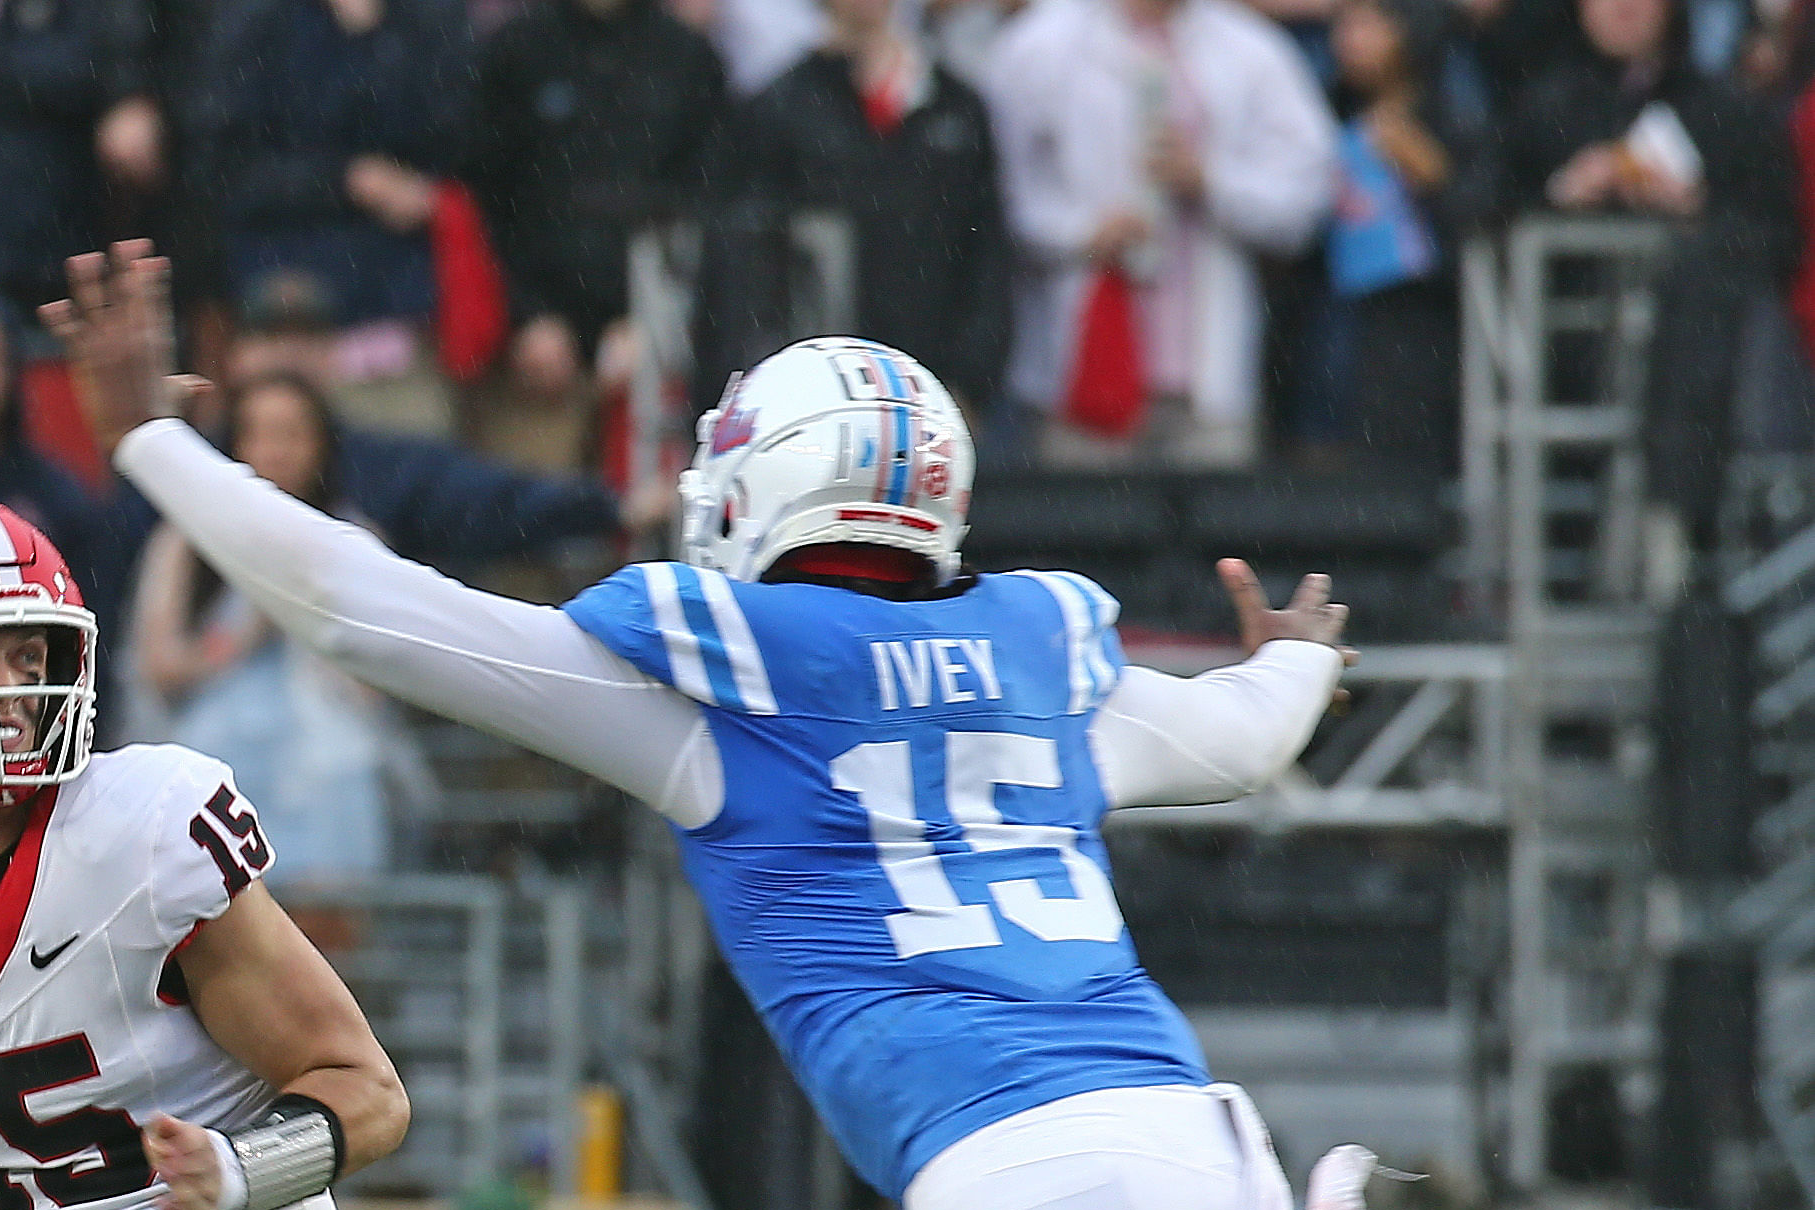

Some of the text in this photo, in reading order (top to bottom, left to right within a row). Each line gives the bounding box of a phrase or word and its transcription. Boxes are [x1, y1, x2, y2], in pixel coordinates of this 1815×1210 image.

[870, 638, 1003, 711] IVEY
[189, 784, 271, 898] 15
[828, 731, 1124, 959] 15
